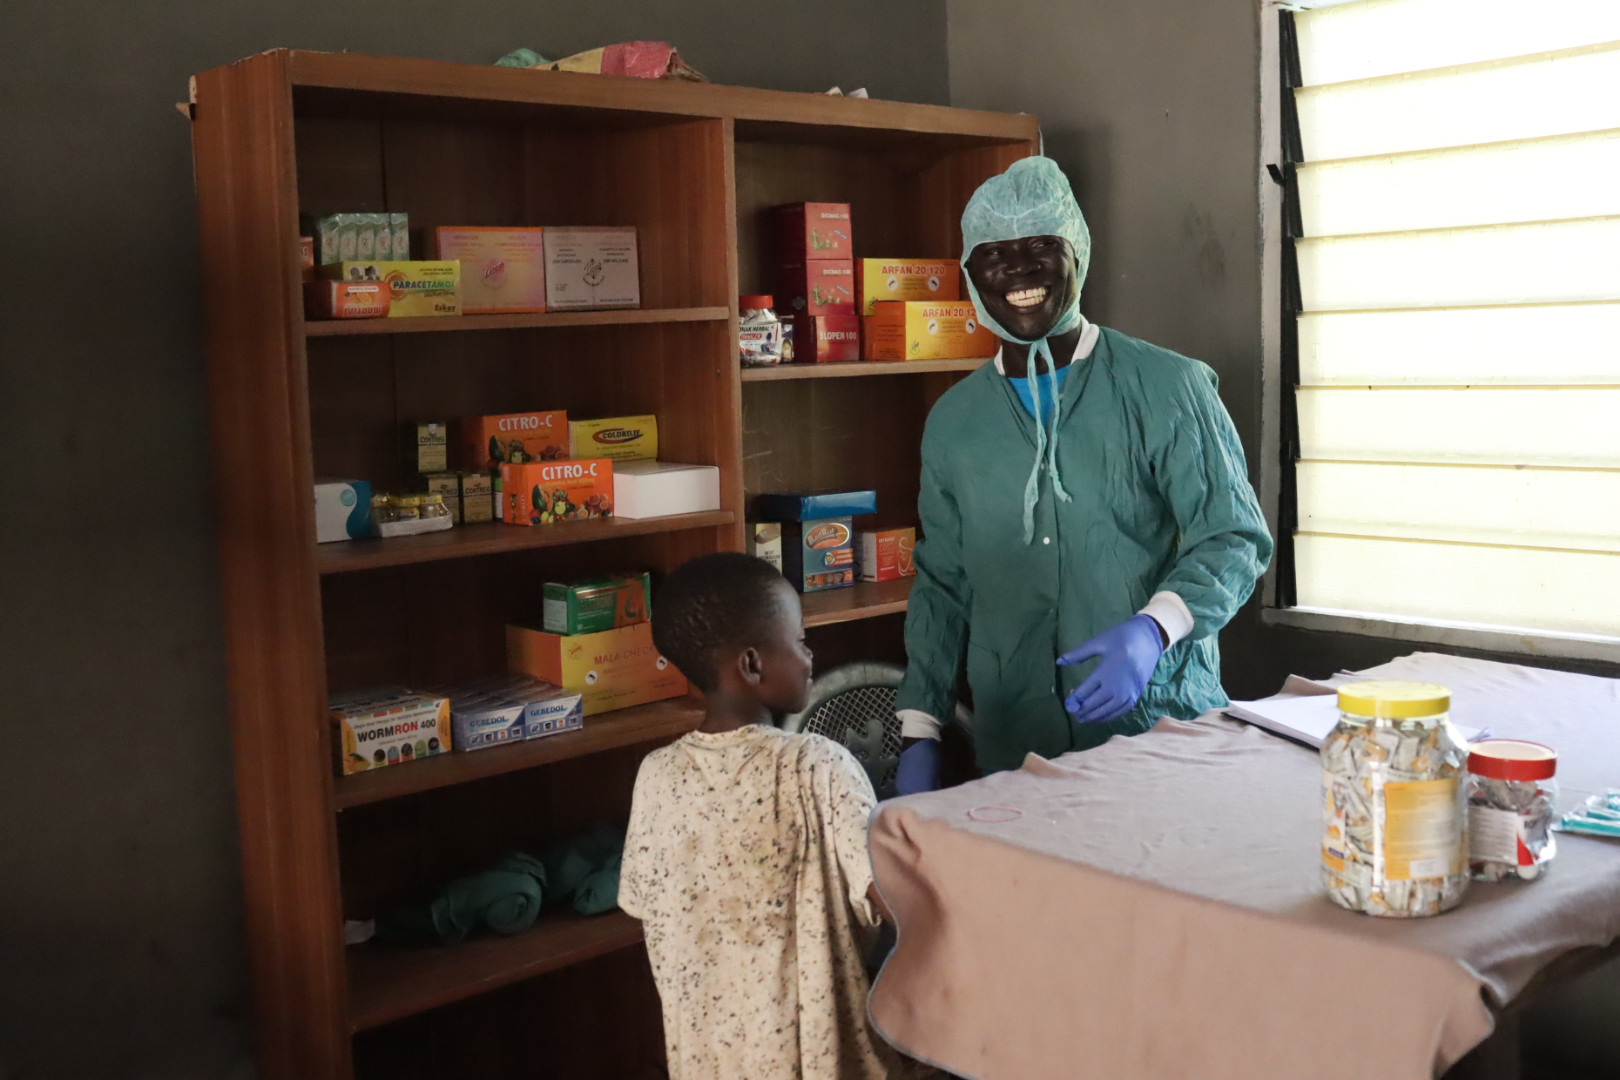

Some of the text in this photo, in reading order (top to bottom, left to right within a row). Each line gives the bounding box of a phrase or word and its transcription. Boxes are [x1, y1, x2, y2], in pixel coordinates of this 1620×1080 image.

[881, 265, 946, 275] ARFAN 20 120
[392, 280, 457, 290] PARACETAMOL
[922, 308, 976, 318] ARFAN 20 12
[498, 413, 554, 432] CITRO-C
[541, 462, 599, 481] CITRO-C
[357, 720, 419, 743] WORMRON
[420, 718, 437, 729] 400
